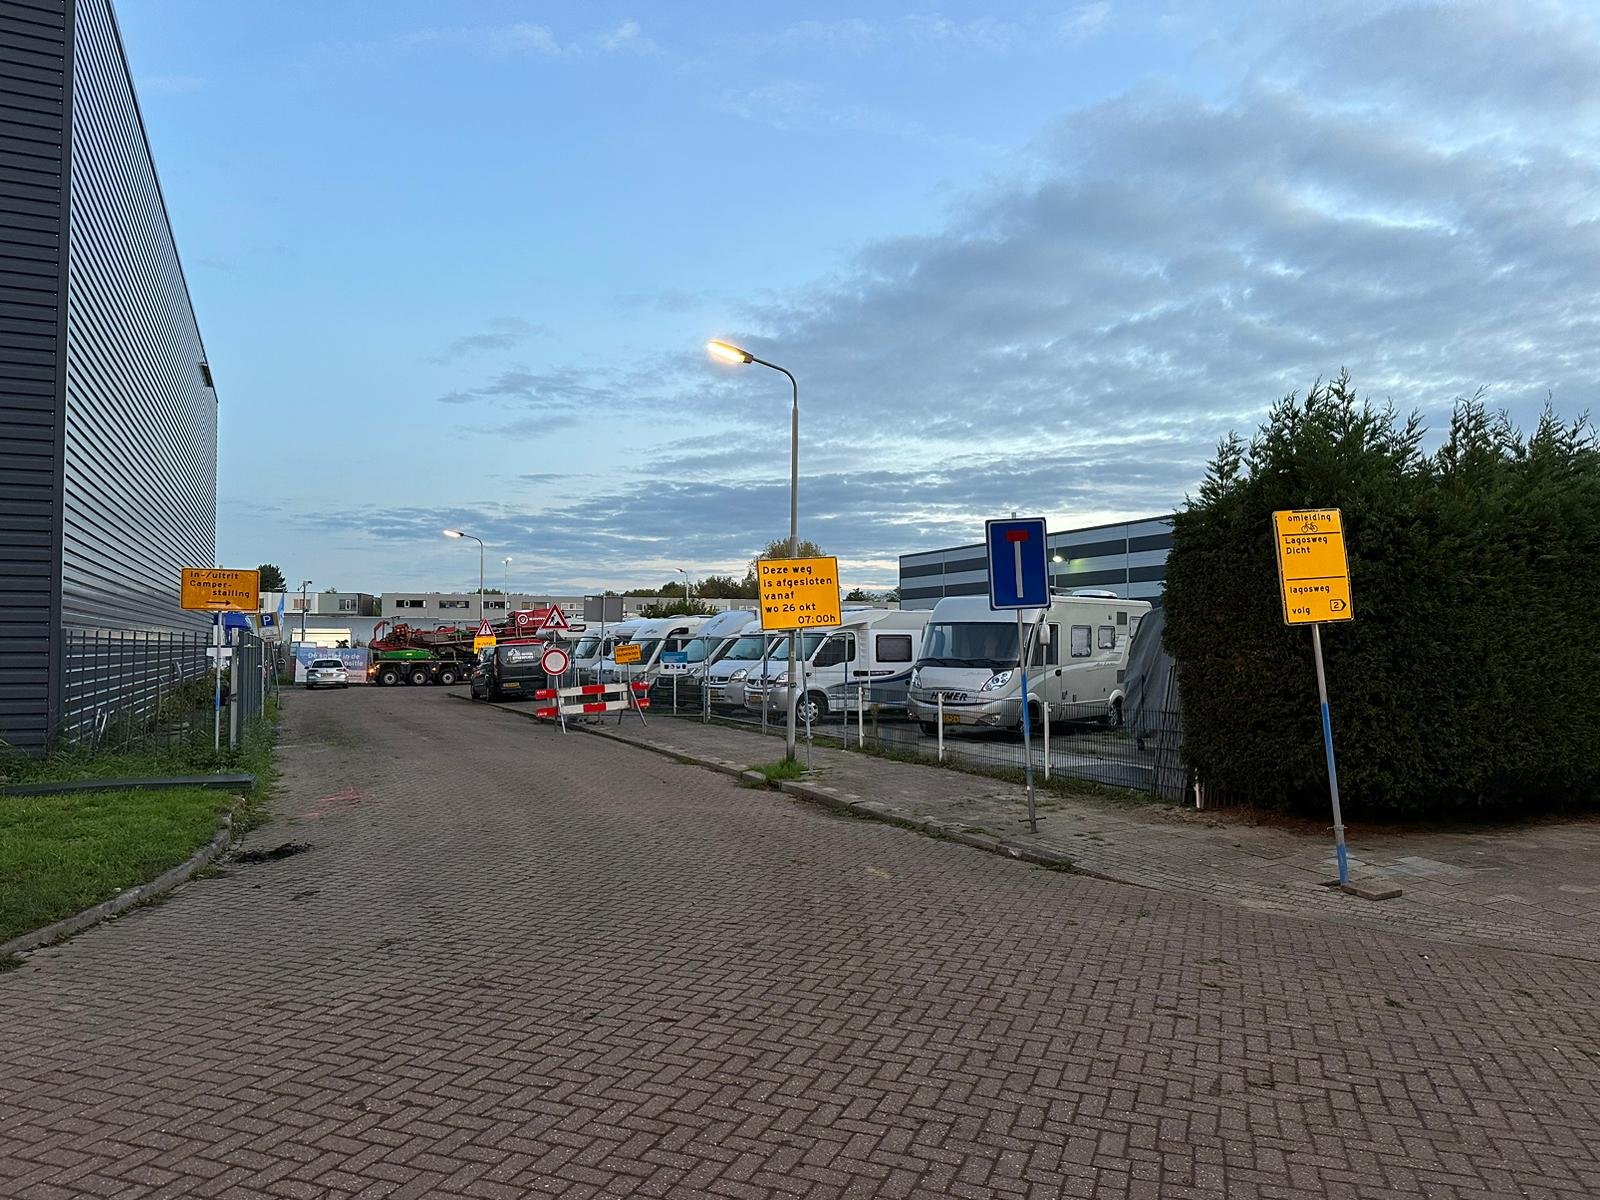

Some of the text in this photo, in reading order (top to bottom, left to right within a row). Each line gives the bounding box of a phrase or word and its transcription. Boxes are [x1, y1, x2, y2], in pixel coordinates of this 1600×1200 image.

[1287, 513, 1331, 522] omleiding
[1285, 536, 1328, 545] Lagosweg
[1286, 546, 1311, 554] Dicht
[762, 566, 812, 575] Deze weg
[189, 580, 232, 588] Camper-
[776, 577, 832, 588] afgesloten
[212, 590, 250, 598] stalling
[1290, 585, 1330, 594] lagosweg
[764, 591, 794, 600] vanaf
[782, 604, 796, 612] 26
[799, 603, 816, 611] okt
[1291, 607, 1311, 615] volg
[262, 615, 271, 625] P
[797, 614, 836, 624] 07:00h
